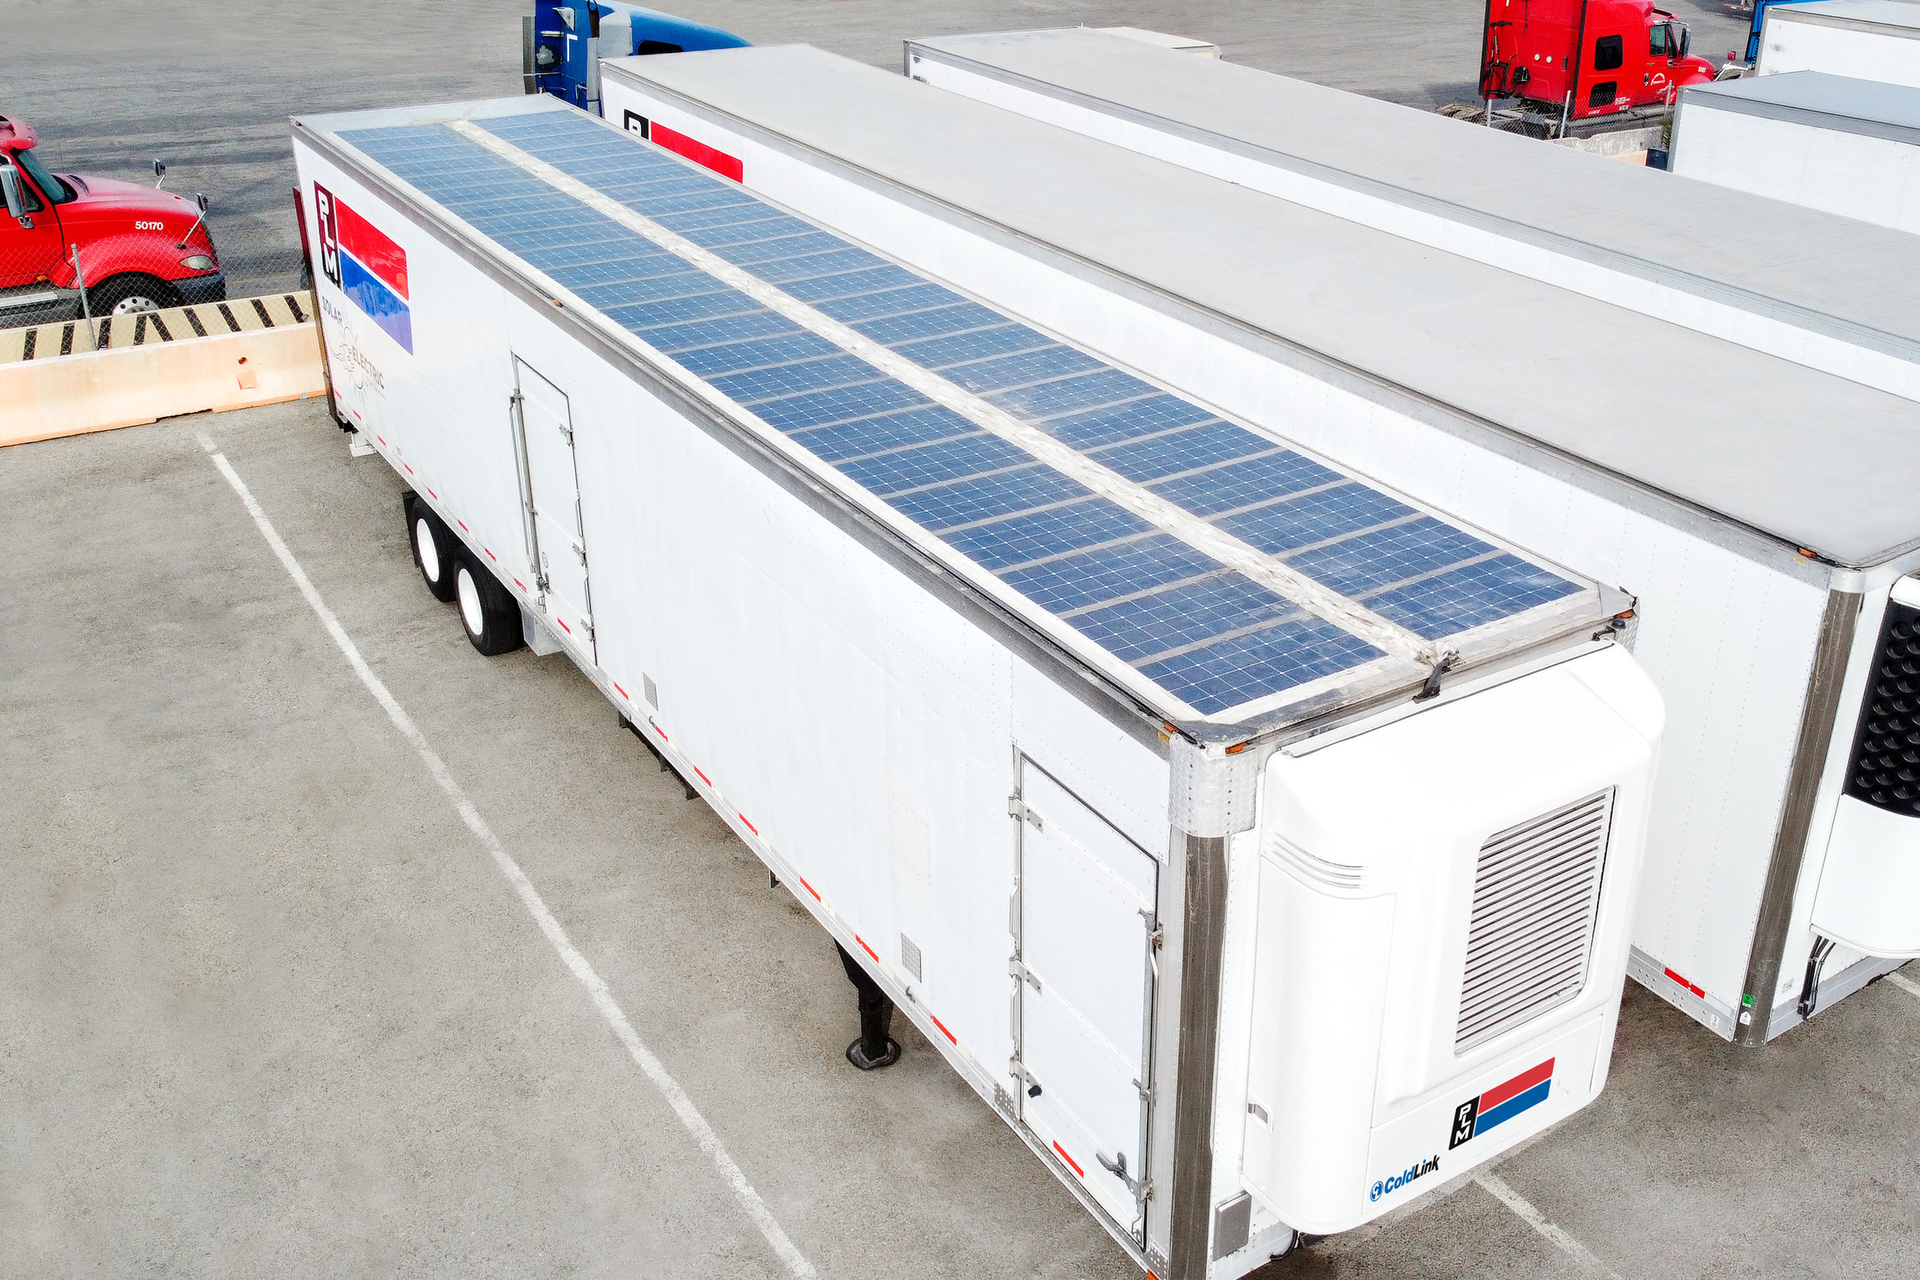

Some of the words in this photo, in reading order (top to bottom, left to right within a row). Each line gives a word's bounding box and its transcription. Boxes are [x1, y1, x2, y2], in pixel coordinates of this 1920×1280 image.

[135, 221, 164, 231] 50170
[318, 189, 339, 281] PLM
[321, 295, 343, 326] SOLAR
[352, 345, 385, 390] ELECTRIC
[1454, 1103, 1472, 1146] PLM
[1384, 1154, 1441, 1194] ColdLink
